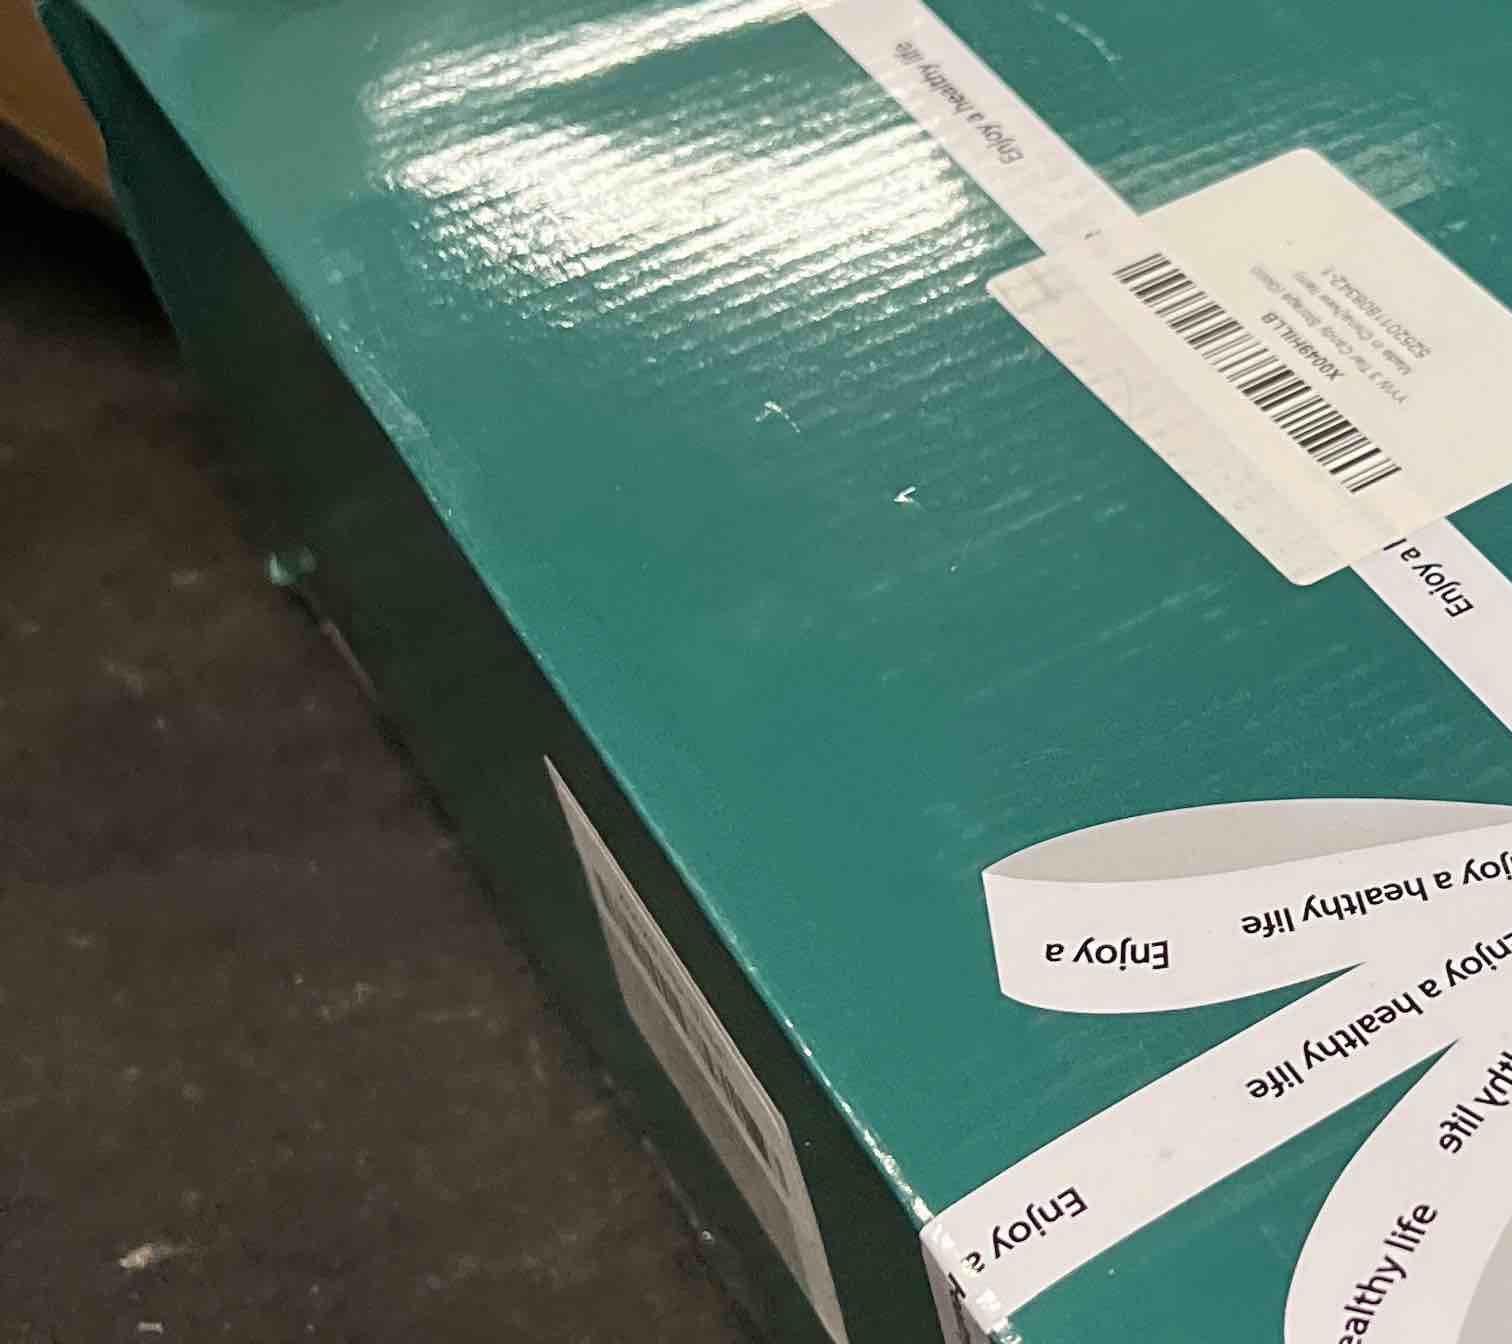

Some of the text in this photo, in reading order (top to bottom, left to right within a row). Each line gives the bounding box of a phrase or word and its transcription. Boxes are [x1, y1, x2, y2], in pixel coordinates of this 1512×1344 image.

[1400, 546, 1474, 617] Enjoy a
[1302, 877, 1428, 922] healthy
[1433, 872, 1453, 889] a
[1241, 908, 1295, 938] life
[1046, 937, 1169, 971] Enjoy a
[1417, 979, 1442, 998] a
[1304, 992, 1424, 1070] healthy
[1245, 1061, 1304, 1098] life
[992, 1187, 1088, 1259] Enjoy
[1384, 1205, 1438, 1252] life
